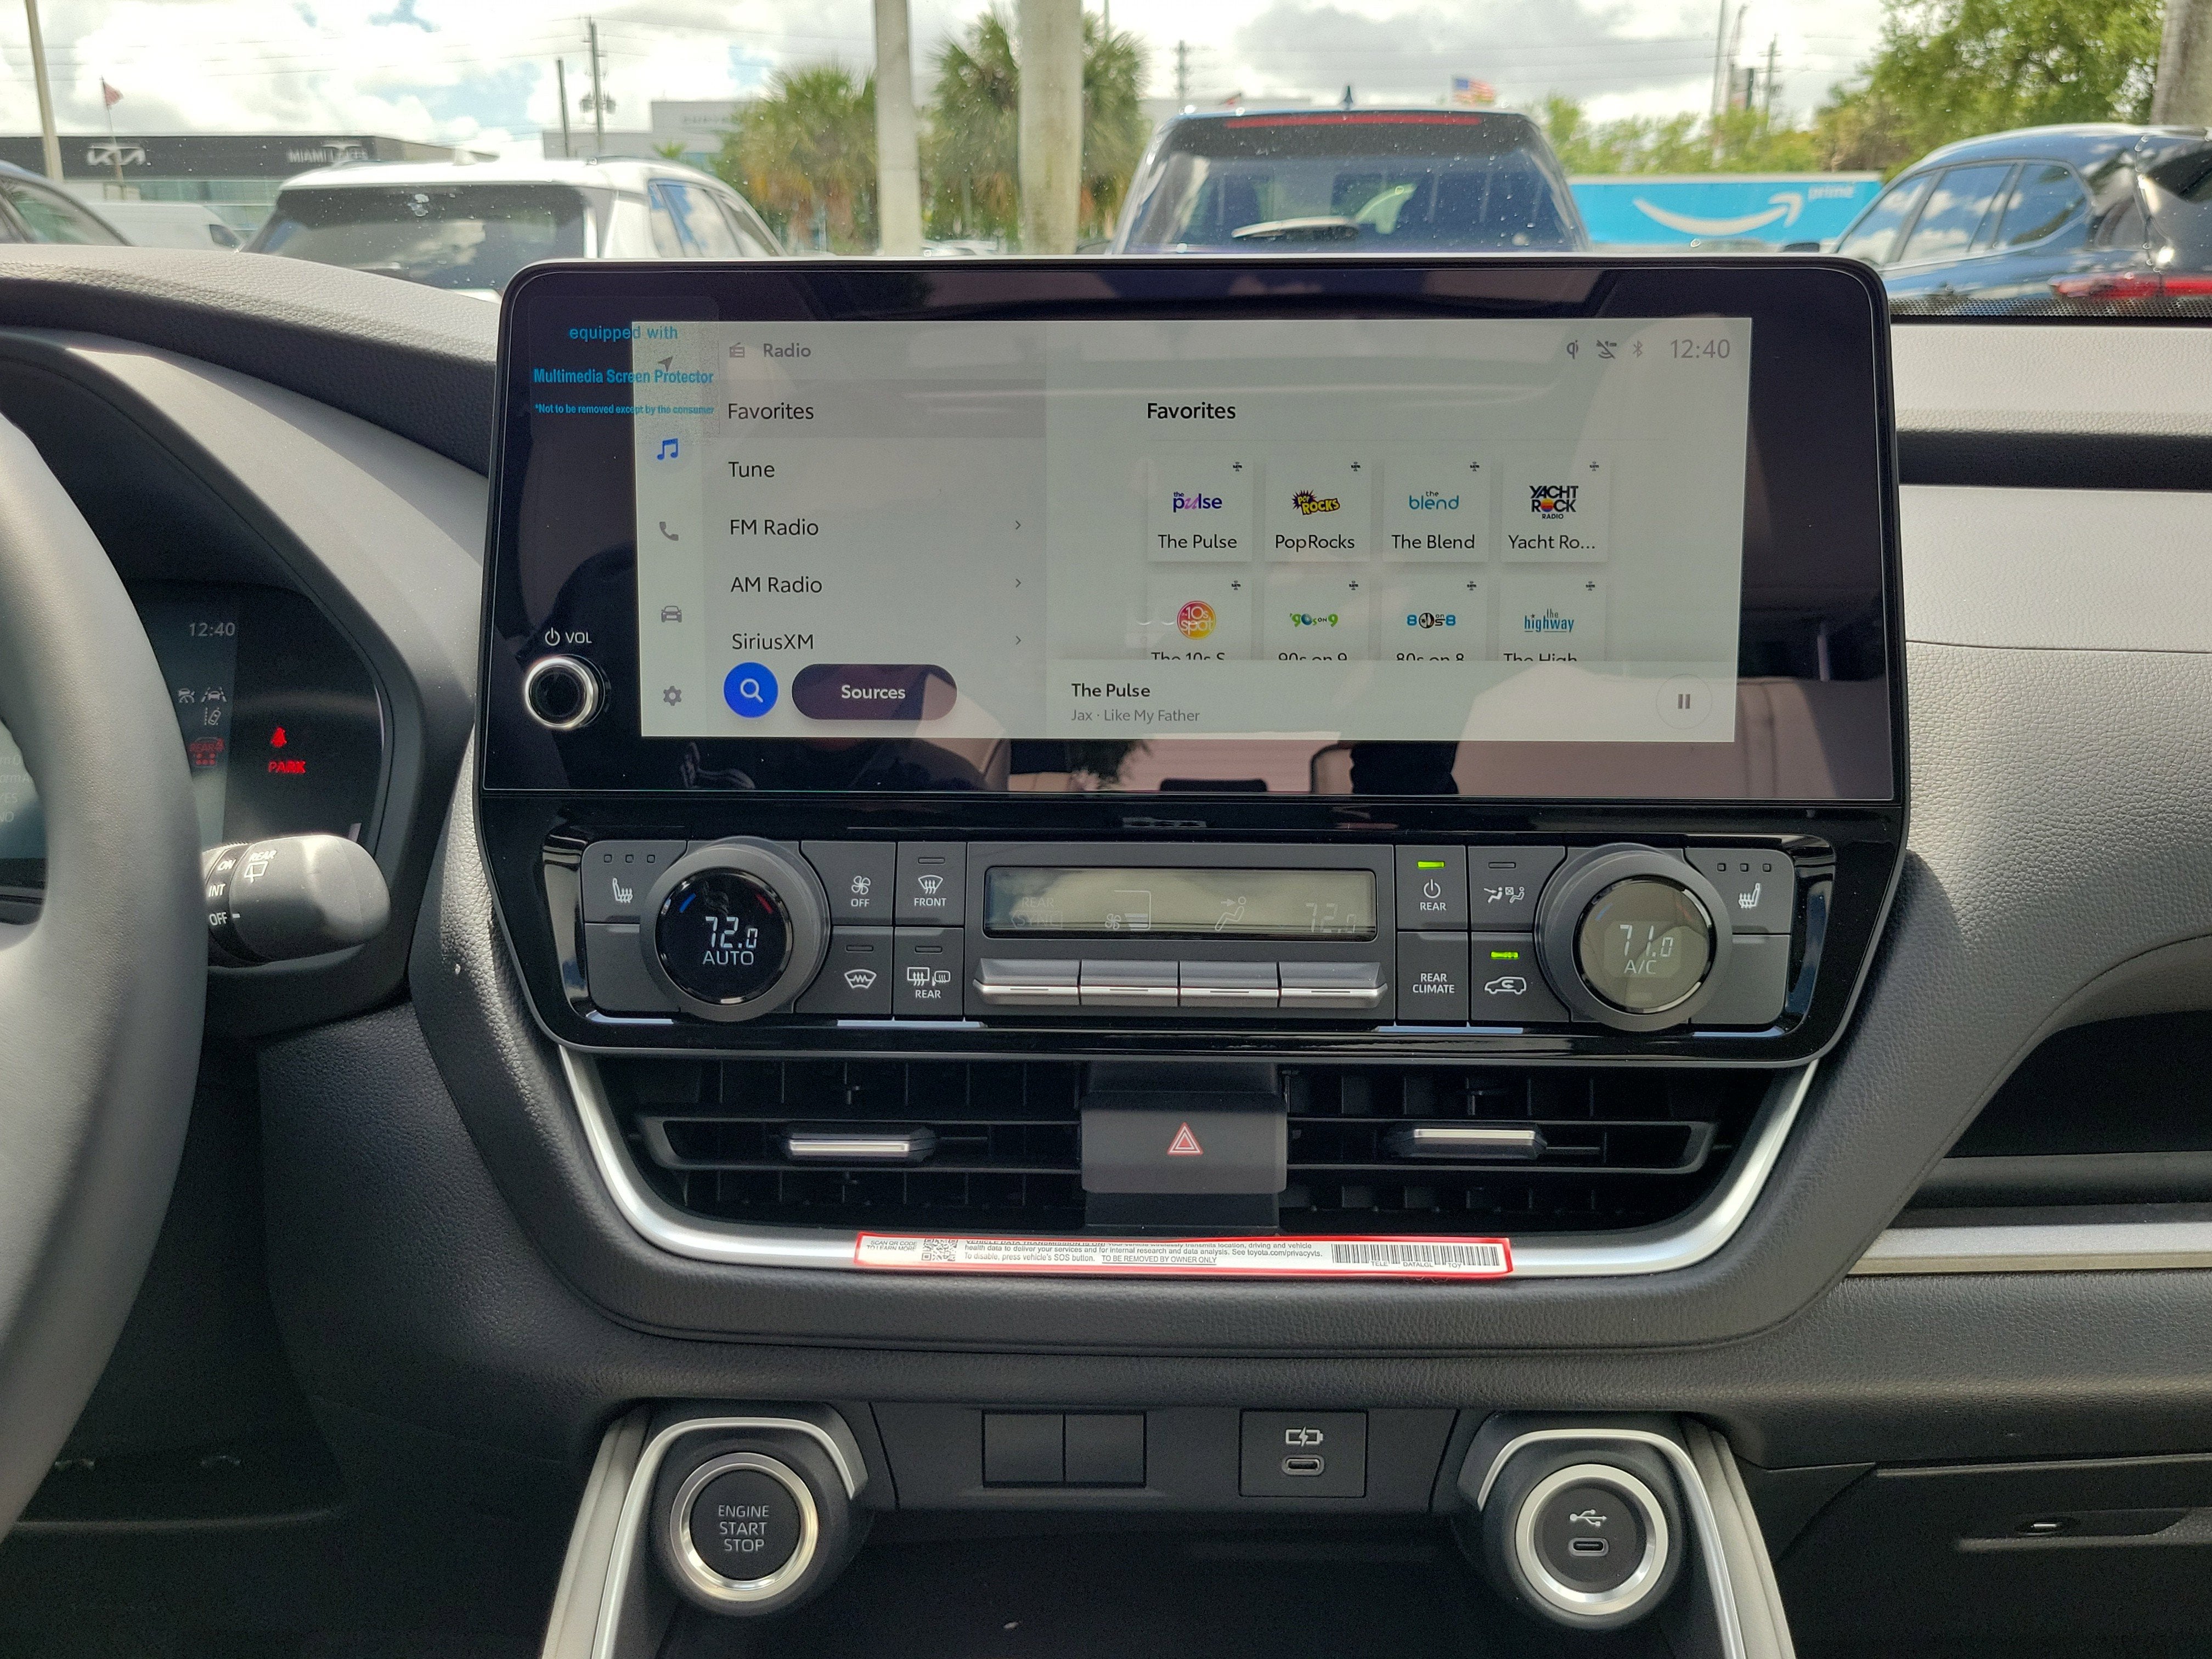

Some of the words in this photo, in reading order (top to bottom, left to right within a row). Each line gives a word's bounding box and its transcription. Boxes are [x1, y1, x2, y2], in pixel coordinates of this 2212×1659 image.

[569, 325, 641, 342] equipped
[647, 326, 677, 339] with
[764, 343, 811, 357] Radio
[1671, 339, 1730, 358] 12:40
[533, 368, 603, 383] Multimedia
[606, 369, 650, 383] Screen
[654, 369, 713, 383] Protector
[556, 405, 563, 413] to
[566, 404, 575, 413] be
[578, 404, 614, 414] removed
[616, 405, 643, 415] except
[645, 405, 654, 415] by
[657, 405, 670, 414] the
[728, 402, 814, 419] Favorites
[1147, 403, 1237, 420] Favorites
[729, 461, 775, 478] Tune
[1528, 486, 1578, 499] YACHT
[1173, 494, 1222, 512] pulse
[1301, 498, 1340, 515] ROCKS
[1409, 495, 1459, 510] blend
[1531, 498, 1576, 513] ROCK
[730, 520, 757, 535] FM
[764, 518, 819, 535] Radio
[1158, 534, 1187, 549] The
[1193, 534, 1237, 549] Pulse
[1276, 534, 1355, 552] PopRocks
[1391, 535, 1421, 549] The
[1427, 534, 1475, 549] Blend
[1508, 535, 1554, 549] Yacht
[1560, 535, 1595, 549] Ro...
[731, 577, 761, 592] AM
[768, 576, 822, 593] Radio
[1186, 606, 1209, 619] 10s
[1546, 608, 1559, 618] the
[1328, 613, 1339, 628] 9
[1524, 614, 1575, 633] highway
[189, 622, 235, 637] 12:40
[565, 632, 592, 644] VOL
[732, 633, 814, 650] SiriusXM
[841, 685, 906, 699] Sources
[1071, 684, 1102, 697] The
[1106, 683, 1150, 697] Pulse
[1071, 709, 1093, 721] Jax
[1104, 709, 1130, 721] Like
[1135, 709, 1154, 724] My
[1158, 709, 1200, 721] Father
[268, 760, 307, 774] PARK
[249, 850, 277, 862] REAR
[217, 859, 236, 871] ON
[208, 883, 225, 898] INT
[851, 898, 870, 907] OFF
[914, 898, 947, 907] FRONT
[1022, 896, 1054, 908] REAR
[1420, 902, 1447, 911] REAR
[209, 912, 228, 926] OFF
[706, 916, 758, 949] 72.0
[1620, 924, 1673, 957] 71.0
[702, 951, 754, 966] AUTO
[1624, 960, 1657, 975] A/C
[1420, 973, 1447, 982] REAR
[915, 990, 941, 998] REAR
[1413, 984, 1455, 994] CLIMATE
[974, 1252, 1000, 1261] disable,
[719, 1505, 769, 1517] ENGINE
[720, 1521, 768, 1535] START
[724, 1538, 764, 1552] STOP
